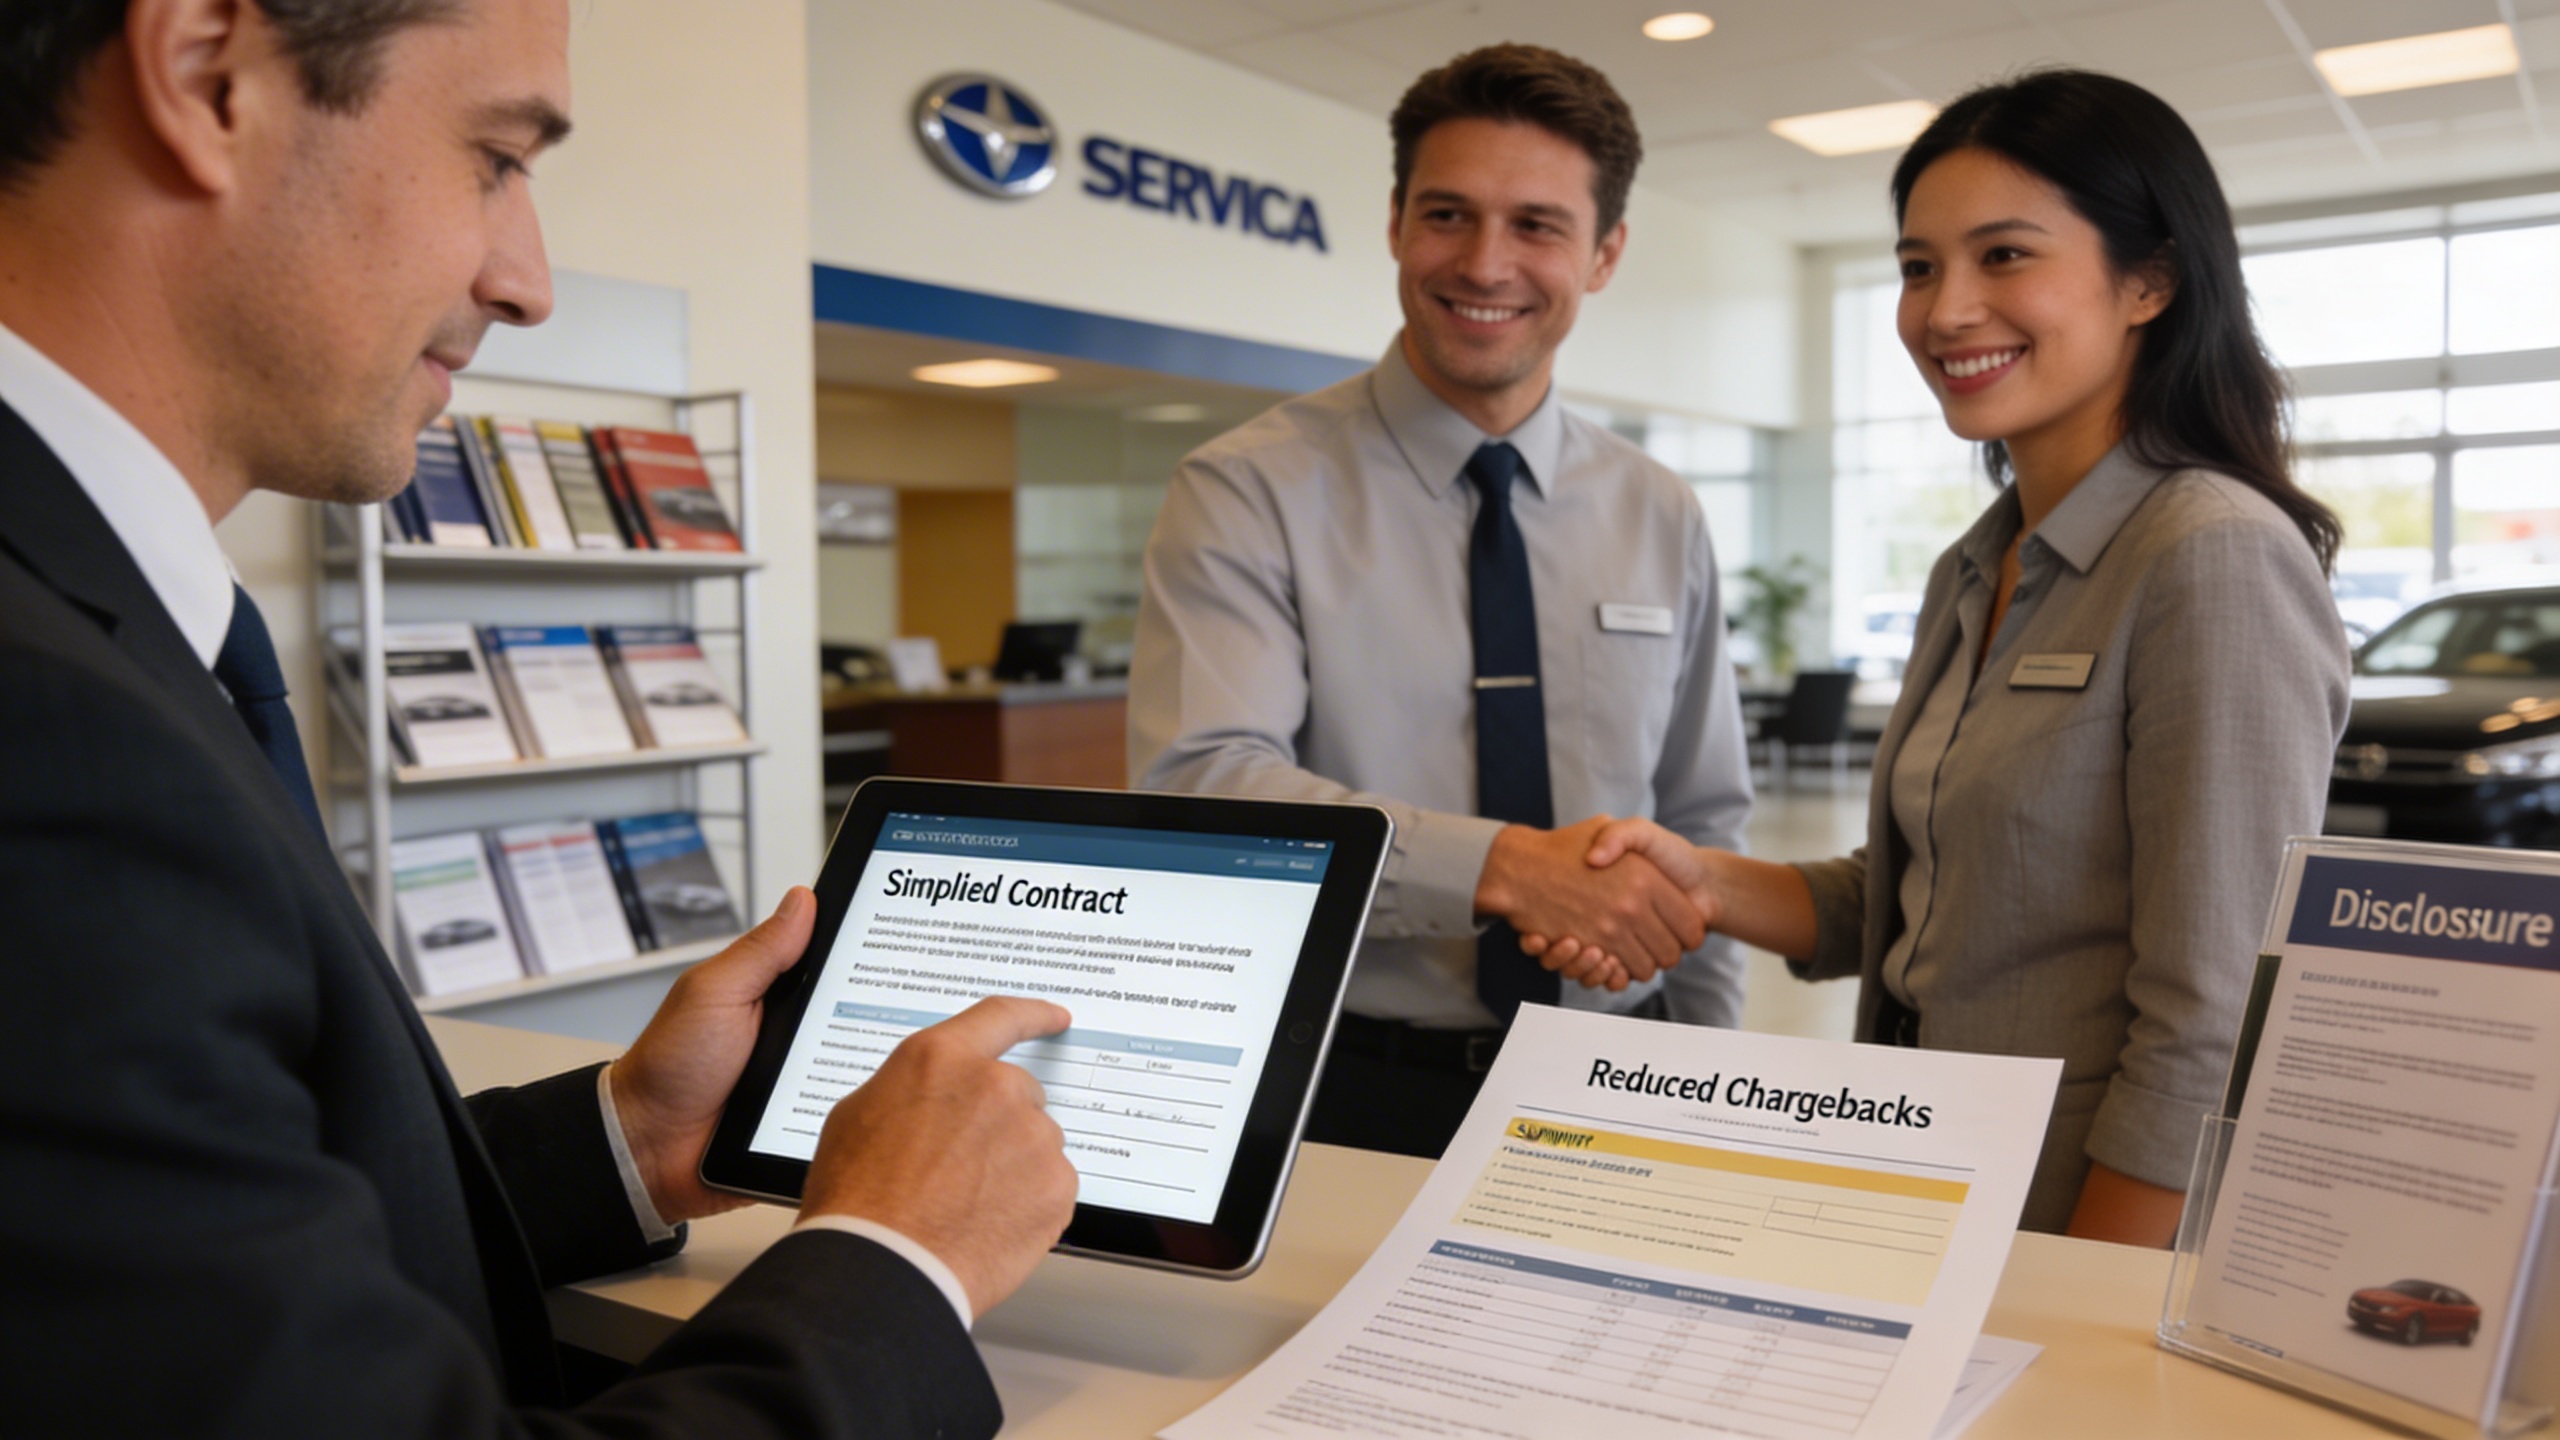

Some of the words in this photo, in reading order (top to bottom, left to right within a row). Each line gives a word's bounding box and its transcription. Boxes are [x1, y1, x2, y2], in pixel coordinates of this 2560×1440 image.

[1082, 136, 1329, 253] SERVICA
[883, 868, 1003, 906] Simplied
[1009, 879, 1128, 914] Contract
[1587, 1058, 1720, 1104] Reduced
[1725, 1077, 1933, 1129] Chargebacks
